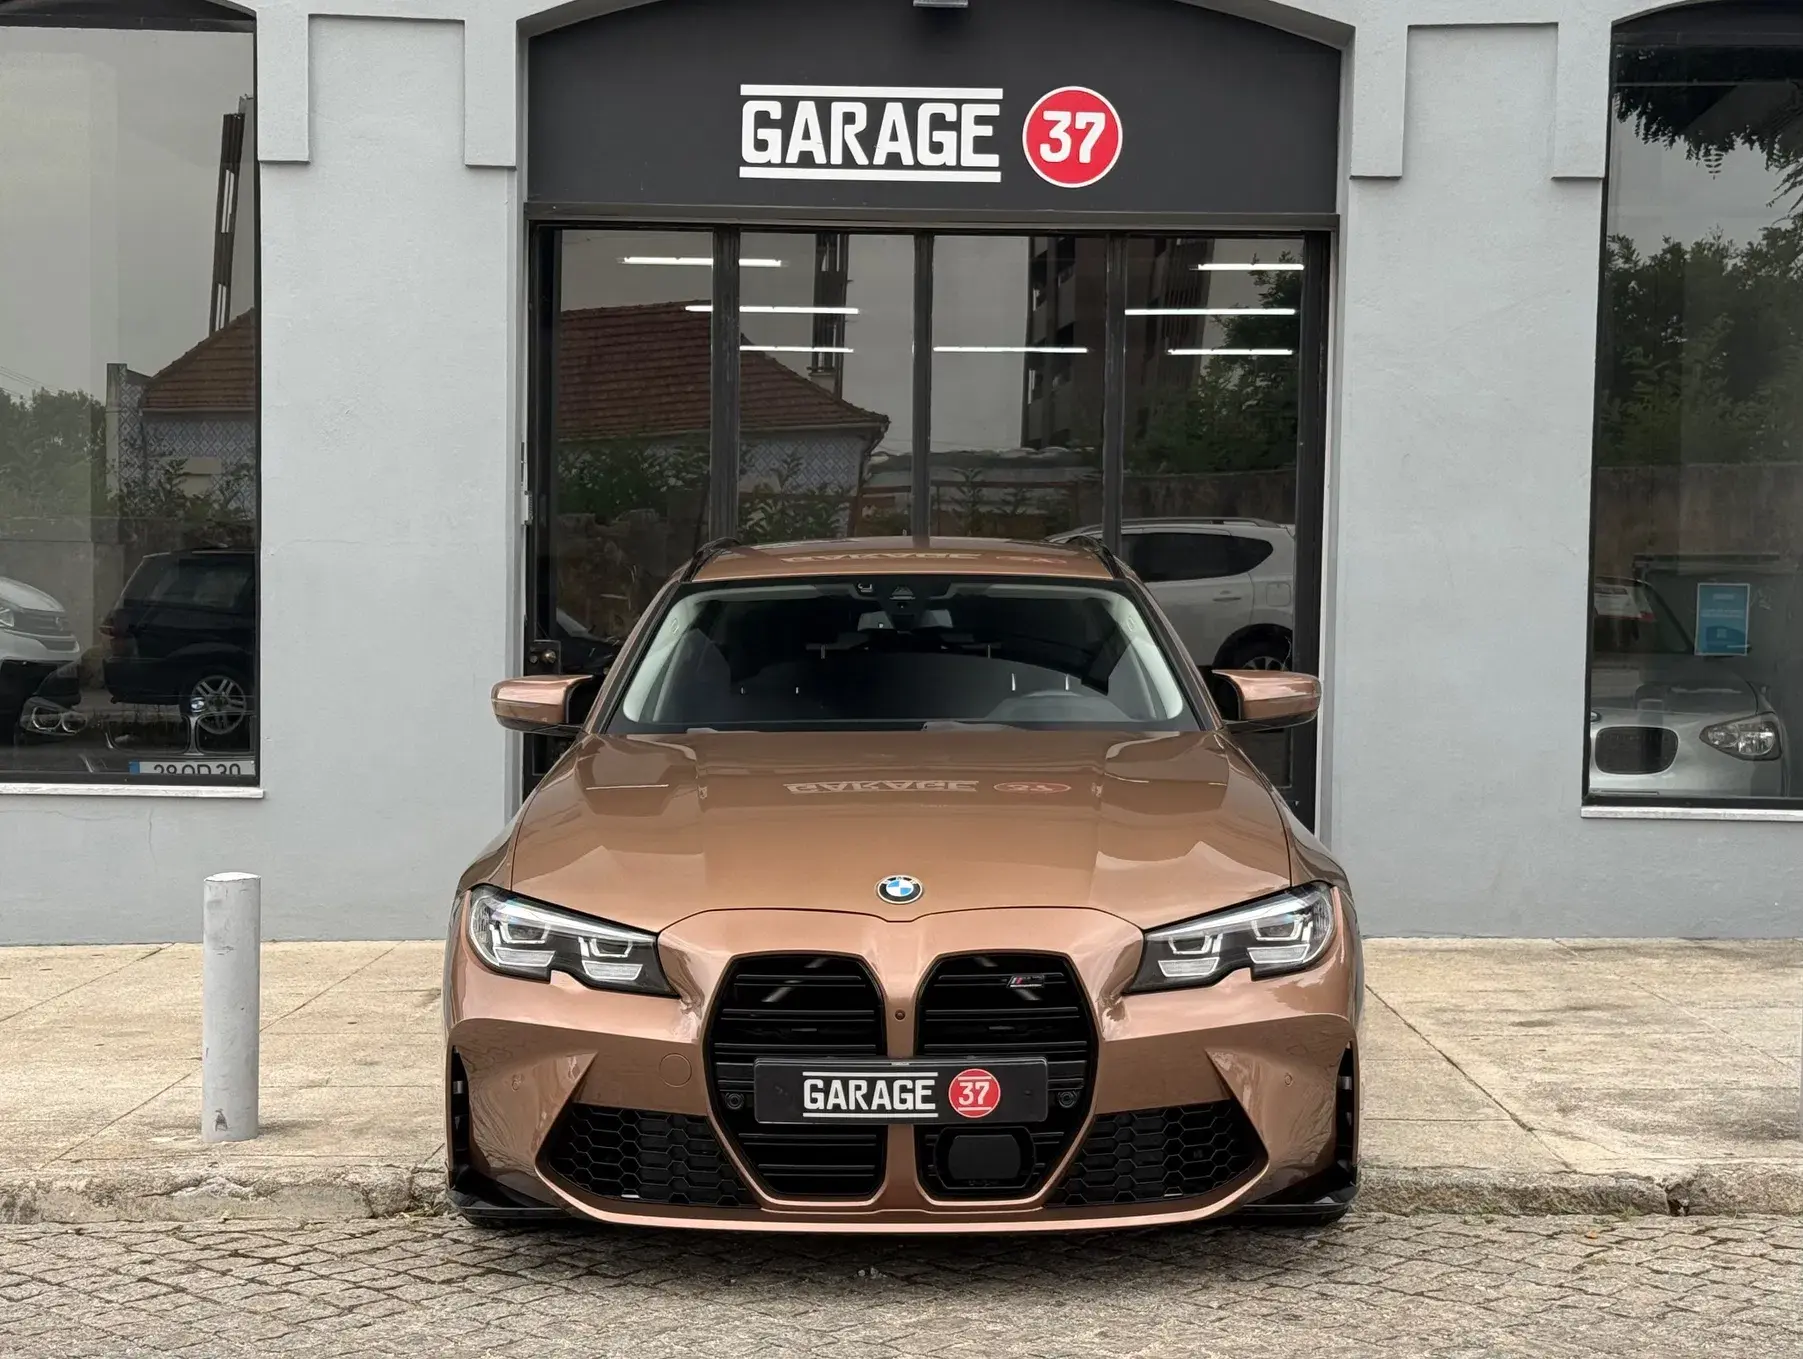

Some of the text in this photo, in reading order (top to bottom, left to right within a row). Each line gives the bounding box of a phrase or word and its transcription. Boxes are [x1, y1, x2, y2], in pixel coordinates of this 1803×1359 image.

[741, 100, 1106, 167] GARAGE 37
[803, 1079, 990, 1111] GARAGE 37
